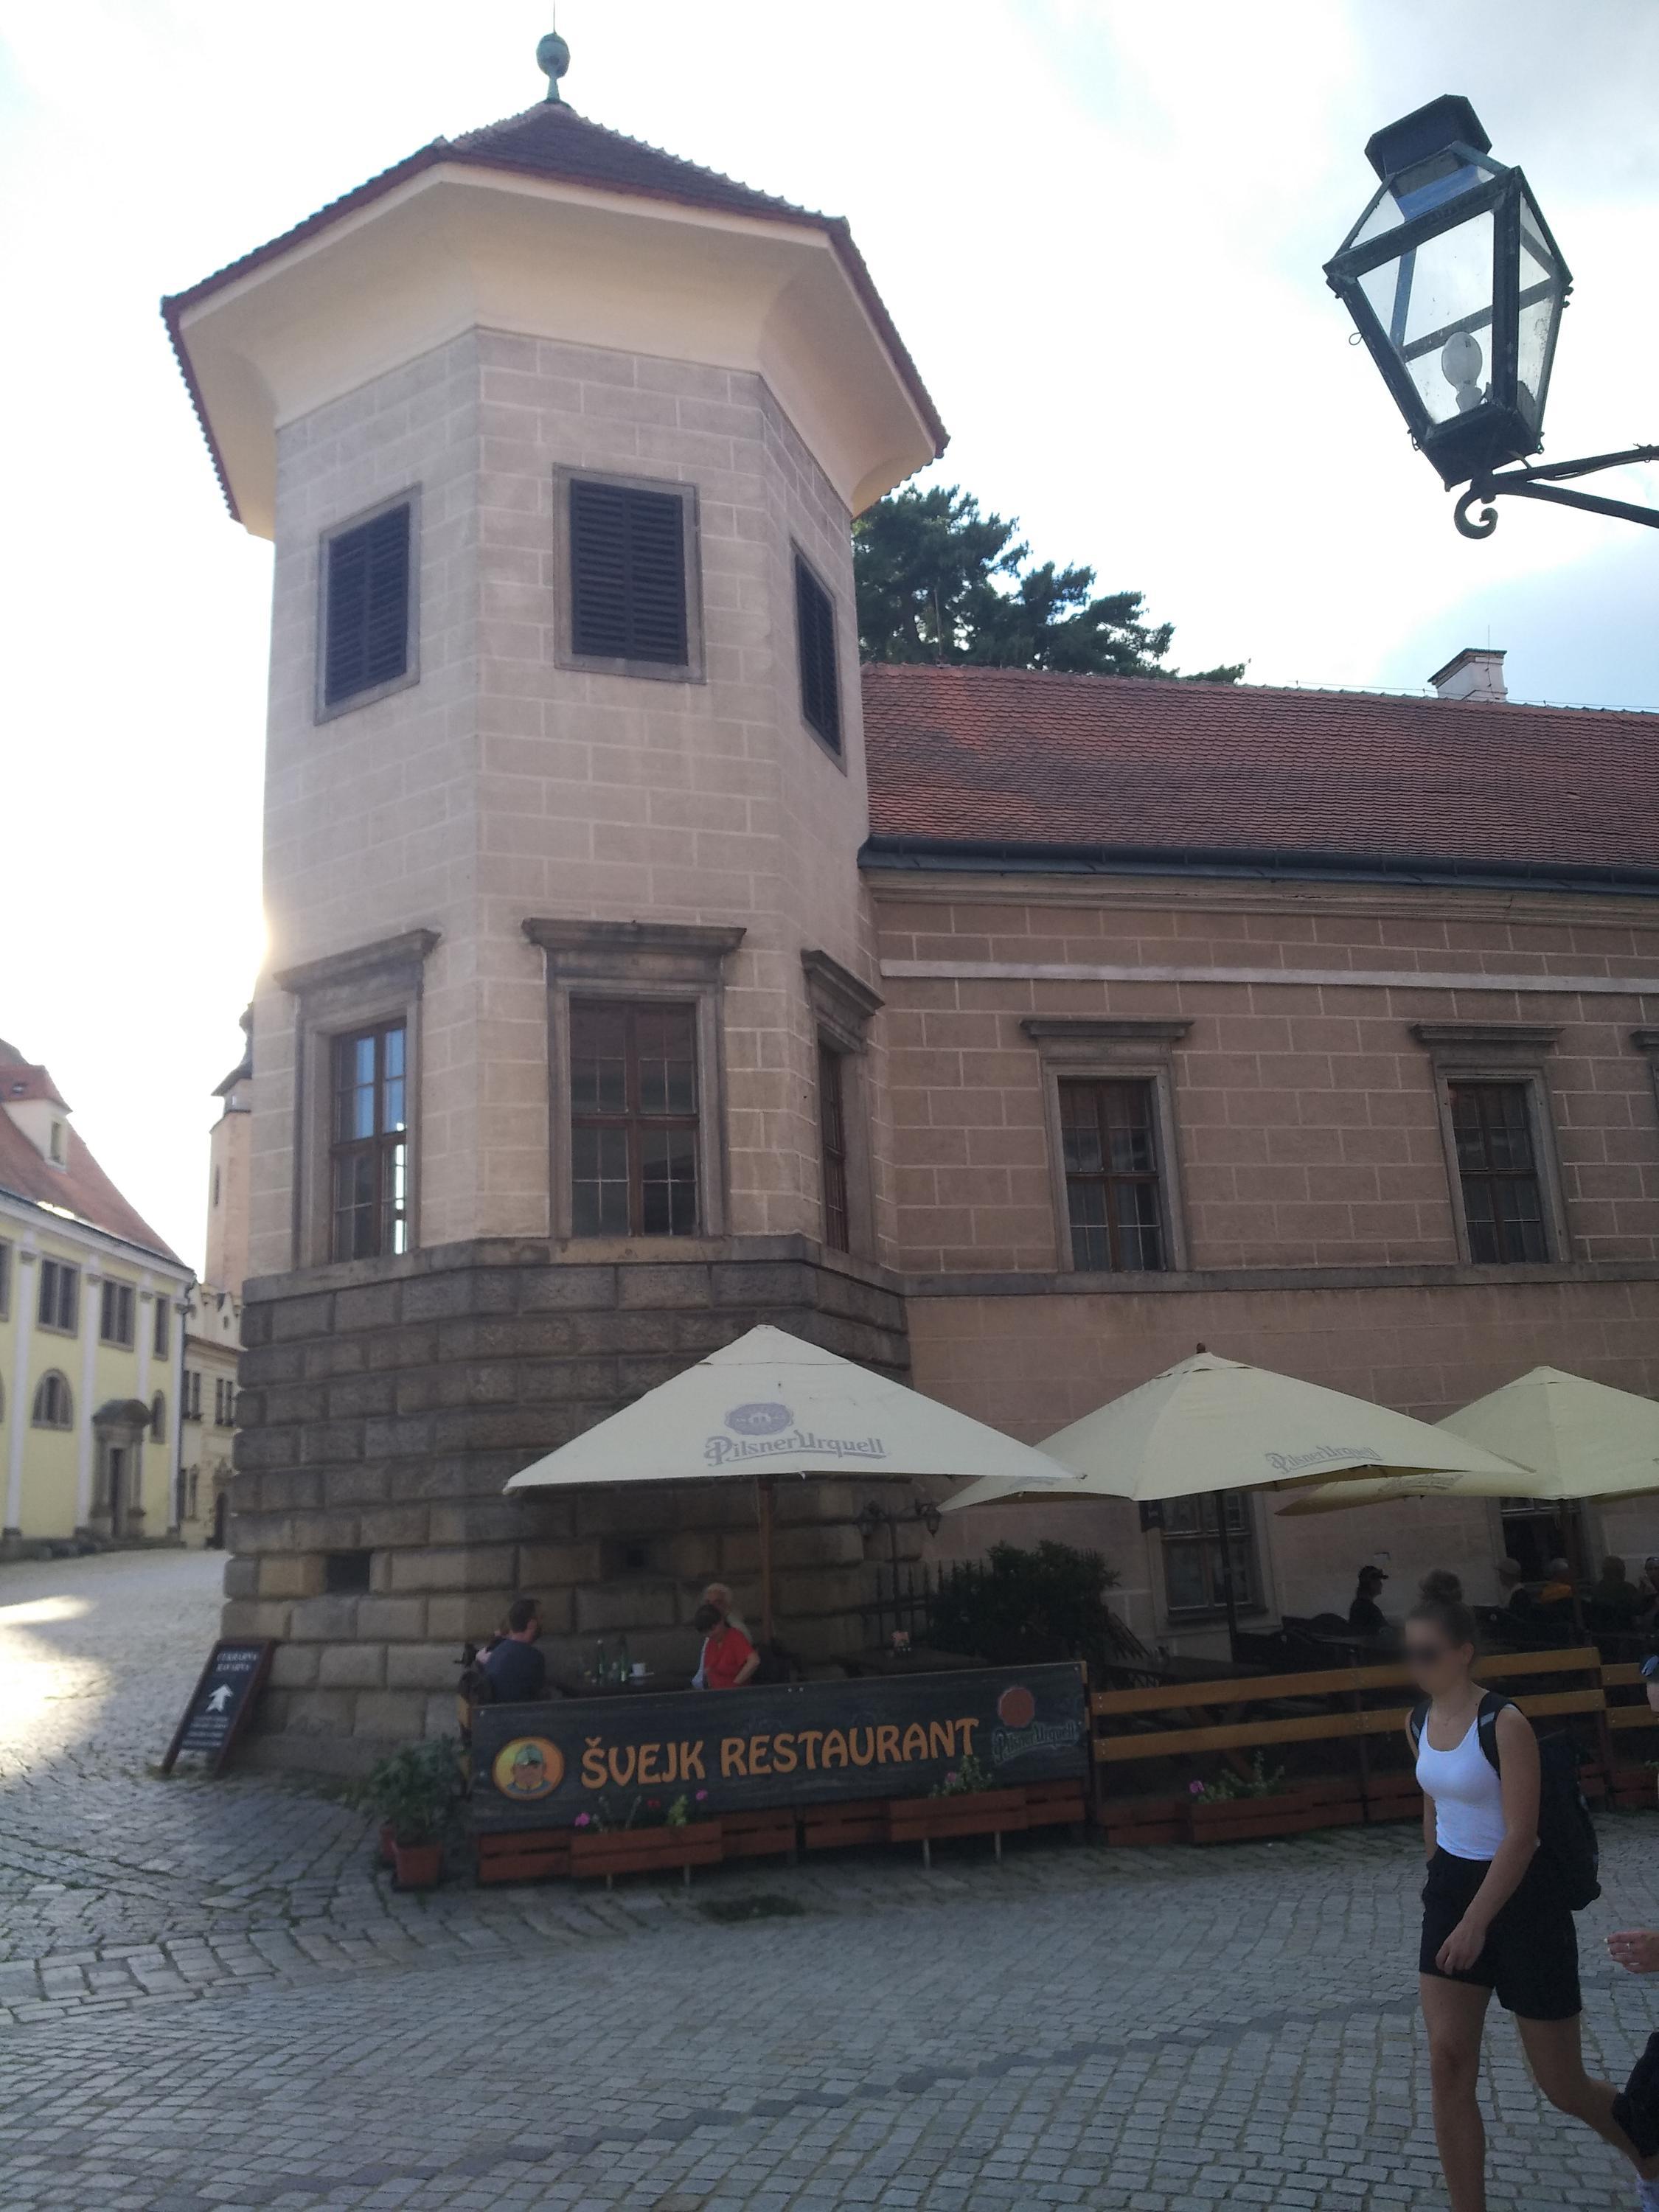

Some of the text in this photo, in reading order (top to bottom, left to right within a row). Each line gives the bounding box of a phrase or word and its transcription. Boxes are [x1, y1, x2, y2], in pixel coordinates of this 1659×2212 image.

[704, 1430, 886, 1467] Pilsner Urquell
[1265, 1452, 1325, 1474] Pilsner
[581, 1718, 978, 1789] ŠVEJK RESTAURANT
[992, 1721, 1078, 1764] Pilsner Urquell
